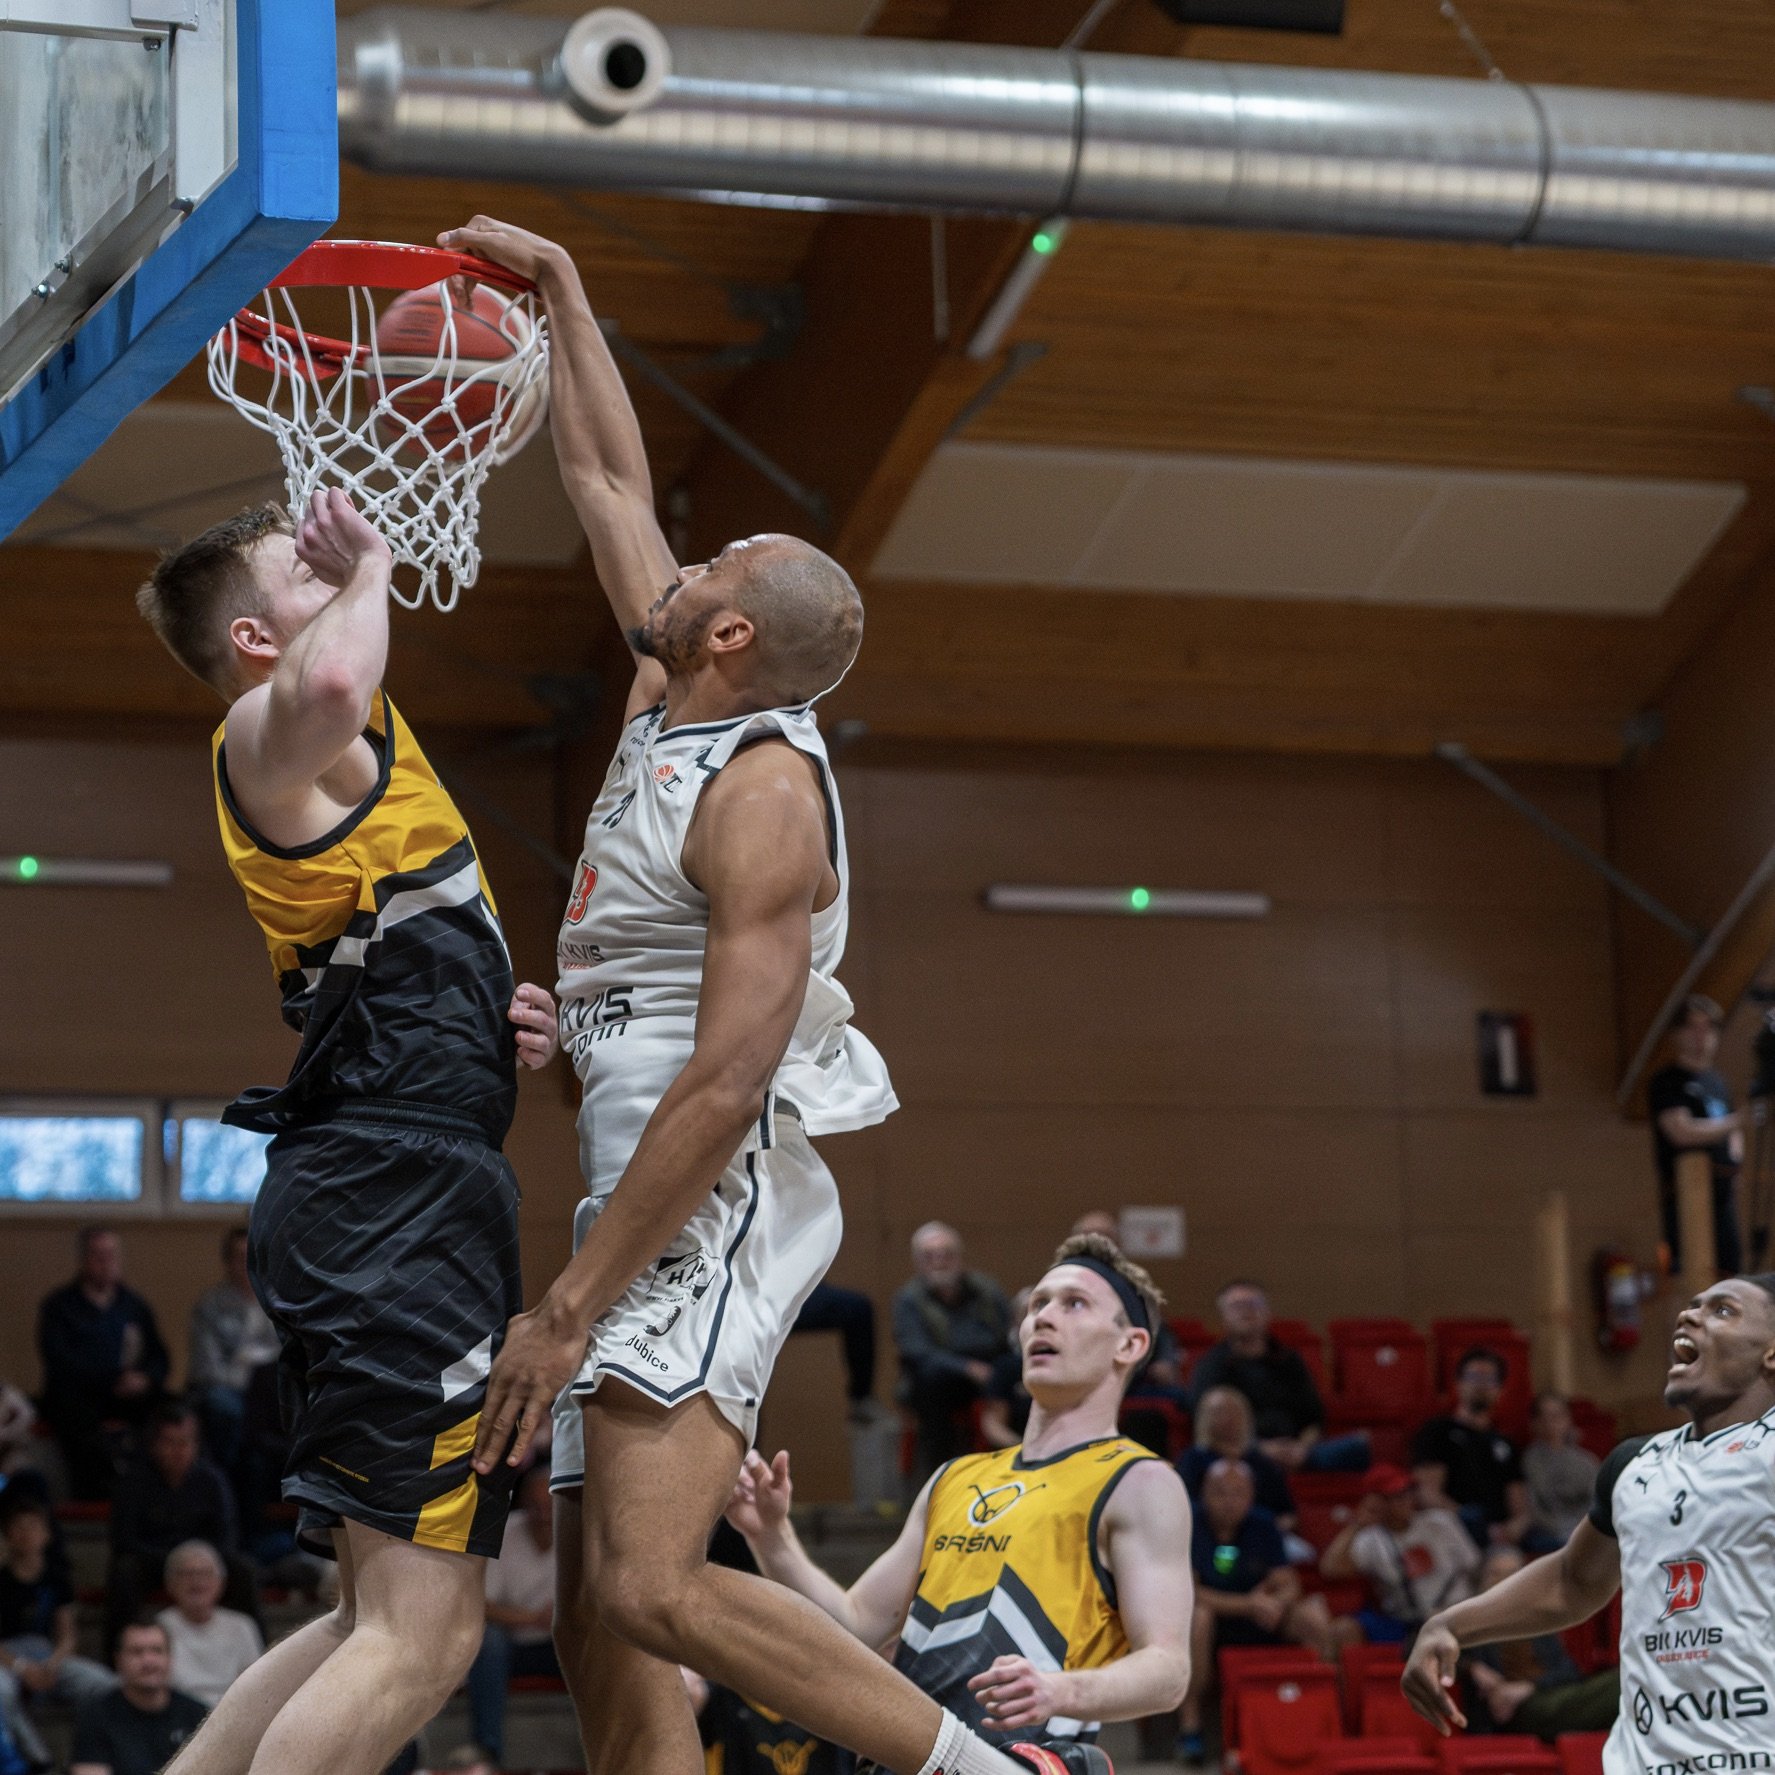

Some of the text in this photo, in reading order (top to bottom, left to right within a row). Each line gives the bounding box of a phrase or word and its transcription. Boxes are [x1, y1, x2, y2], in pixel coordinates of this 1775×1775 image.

[1669, 1489, 1687, 1526] 3
[934, 1531, 1012, 1553] SRŠNI
[1674, 1627, 1724, 1649] KVIS
[1658, 1684, 1769, 1725] KVIS
